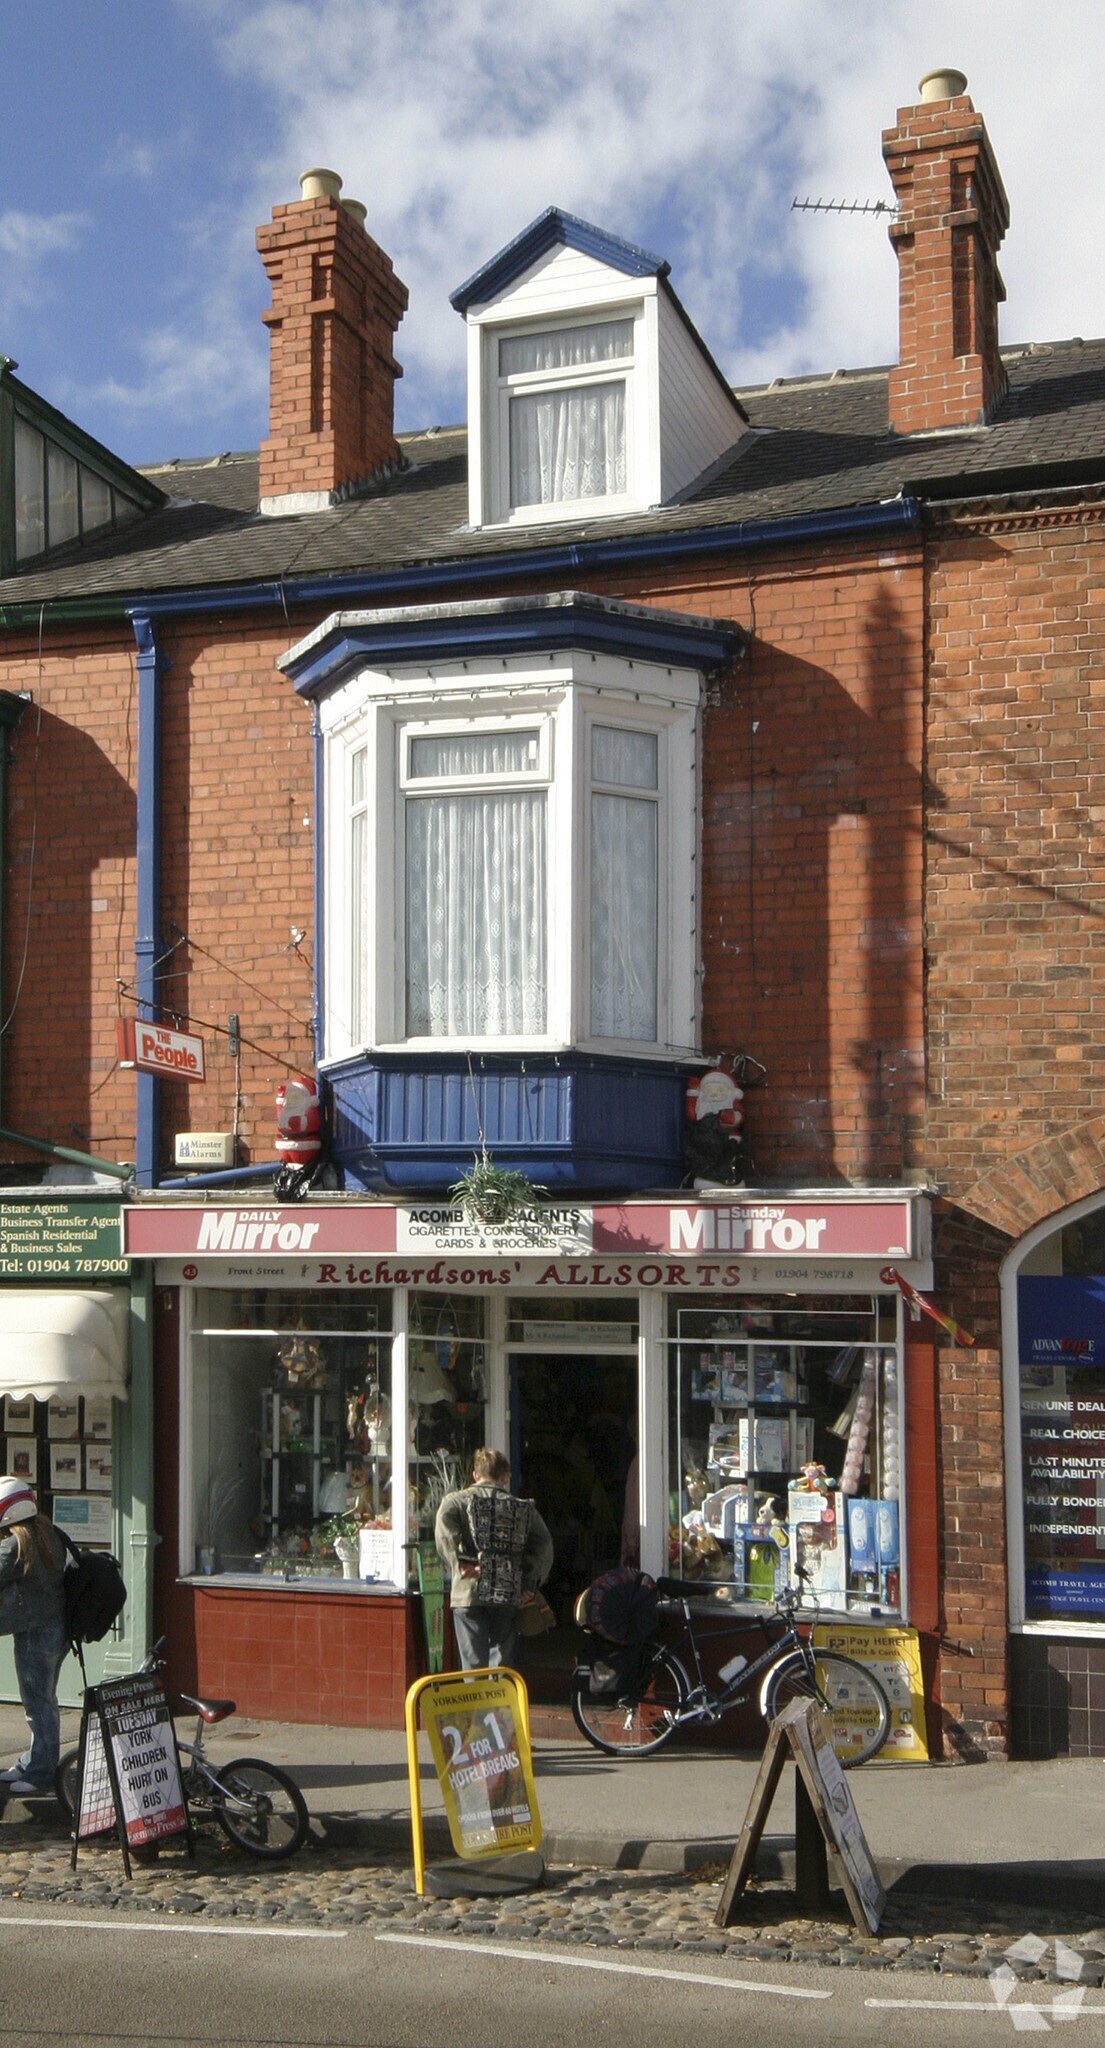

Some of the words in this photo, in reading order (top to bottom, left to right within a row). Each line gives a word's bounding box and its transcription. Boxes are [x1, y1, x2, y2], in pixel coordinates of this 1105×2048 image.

[156, 1030, 171, 1044] THE
[142, 1034, 197, 1069] People
[190, 1140, 222, 1149] Minster
[190, 1150, 222, 1158] Alarms
[1, 1204, 31, 1214] Estate
[33, 1204, 68, 1216] Agents
[239, 1212, 282, 1221] DAILY
[409, 1210, 464, 1223] ACOMB
[731, 1207, 785, 1220] Sunday
[1, 1217, 43, 1227] Business
[45, 1216, 88, 1227] Transfer
[0, 1230, 40, 1242] Spanish
[42, 1230, 98, 1240] Residential
[196, 1211, 320, 1250] Mirror
[669, 1209, 826, 1250] Mirror
[0, 1244, 8, 1253] &
[11, 1243, 54, 1253] Business
[56, 1242, 82, 1253] Sales
[435, 1239, 474, 1248] CARDS
[479, 1239, 486, 1248] &
[1, 1259, 23, 1272] Tel:
[27, 1259, 70, 1272] 01904
[75, 1259, 128, 1272] 787900
[228, 1266, 252, 1276] Front
[256, 1266, 285, 1276] Street
[317, 1260, 521, 1285] Richardsons'
[535, 1264, 741, 1286] ALLSORTS
[775, 1269, 808, 1280] 01904
[813, 1269, 854, 1280] 798718
[1022, 1401, 1074, 1411] GENUINE
[1030, 1428, 1059, 1439] REAL
[1063, 1429, 1105, 1440] CHOICE
[1028, 1456, 1059, 1467] LAST
[1062, 1457, 1105, 1468] MINUTE
[1030, 1468, 1105, 1479] AVAILABILITY
[1026, 1495, 1059, 1506] FULLY
[1063, 1496, 1105, 1508] BONDE
[1029, 1524, 1105, 1536] INDEPENDENT
[1059, 1580, 1087, 1588] TRAVEL
[850, 1636, 870, 1647] Pay
[101, 1685, 134, 1702] Evening
[132, 1682, 155, 1696] Press
[432, 1690, 484, 1707] YORKSHIRE
[484, 1688, 508, 1699] POST
[104, 1706, 119, 1717] ON
[121, 1702, 142, 1714] SALE
[143, 1692, 166, 1706] HERE
[116, 1708, 157, 1733] TUESDAY
[128, 1729, 154, 1748] YORK
[442, 1725, 469, 1766] 2
[470, 1738, 492, 1759] FOR
[483, 1711, 506, 1750] 1
[121, 1747, 166, 1772] CHILDREN
[447, 1765, 482, 1790] HOTEL
[481, 1750, 520, 1778] BREAKS
[128, 1771, 153, 1791] HURT
[154, 1768, 168, 1783] ON
[142, 1792, 162, 1809] BUS
[512, 1803, 529, 1814] HOTELS
[127, 1825, 157, 1843] Evening
[156, 1820, 178, 1833] Press
[511, 1824, 532, 1838] POST
